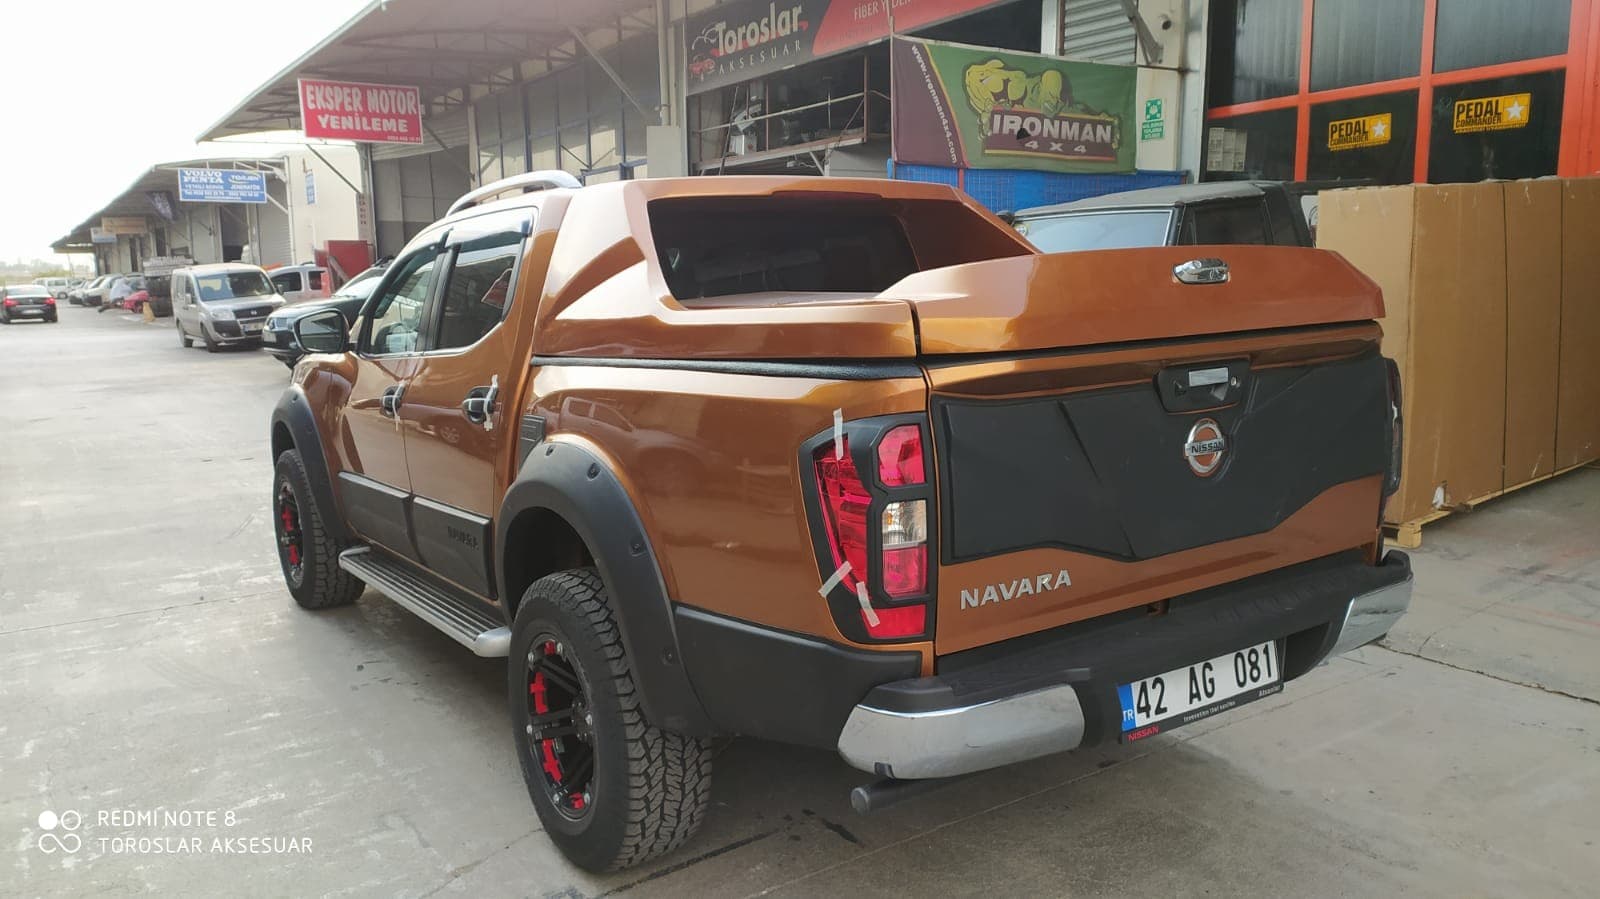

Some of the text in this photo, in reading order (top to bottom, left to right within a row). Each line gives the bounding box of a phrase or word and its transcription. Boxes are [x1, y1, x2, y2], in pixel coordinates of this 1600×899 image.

[715, 2, 802, 56] Toroslar
[719, 40, 801, 74] AKSESUAR
[305, 84, 417, 115] EKSPER MOTOR
[912, 44, 957, 164] www.ironman4x4.com
[1456, 99, 1502, 120] PEDAL
[318, 113, 409, 133] YENİLEME
[992, 114, 1112, 144] IRONMAN
[1330, 119, 1368, 140] PEDAL
[183, 176, 224, 184] PENTA
[184, 169, 222, 177] VOLVO
[1191, 441, 1223, 453] NISSAN
[960, 569, 1072, 610] NAVARA
[1136, 644, 1272, 718] 42 AG 081
[1123, 708, 1134, 722] TR
[1128, 725, 1160, 741] NISSAN
